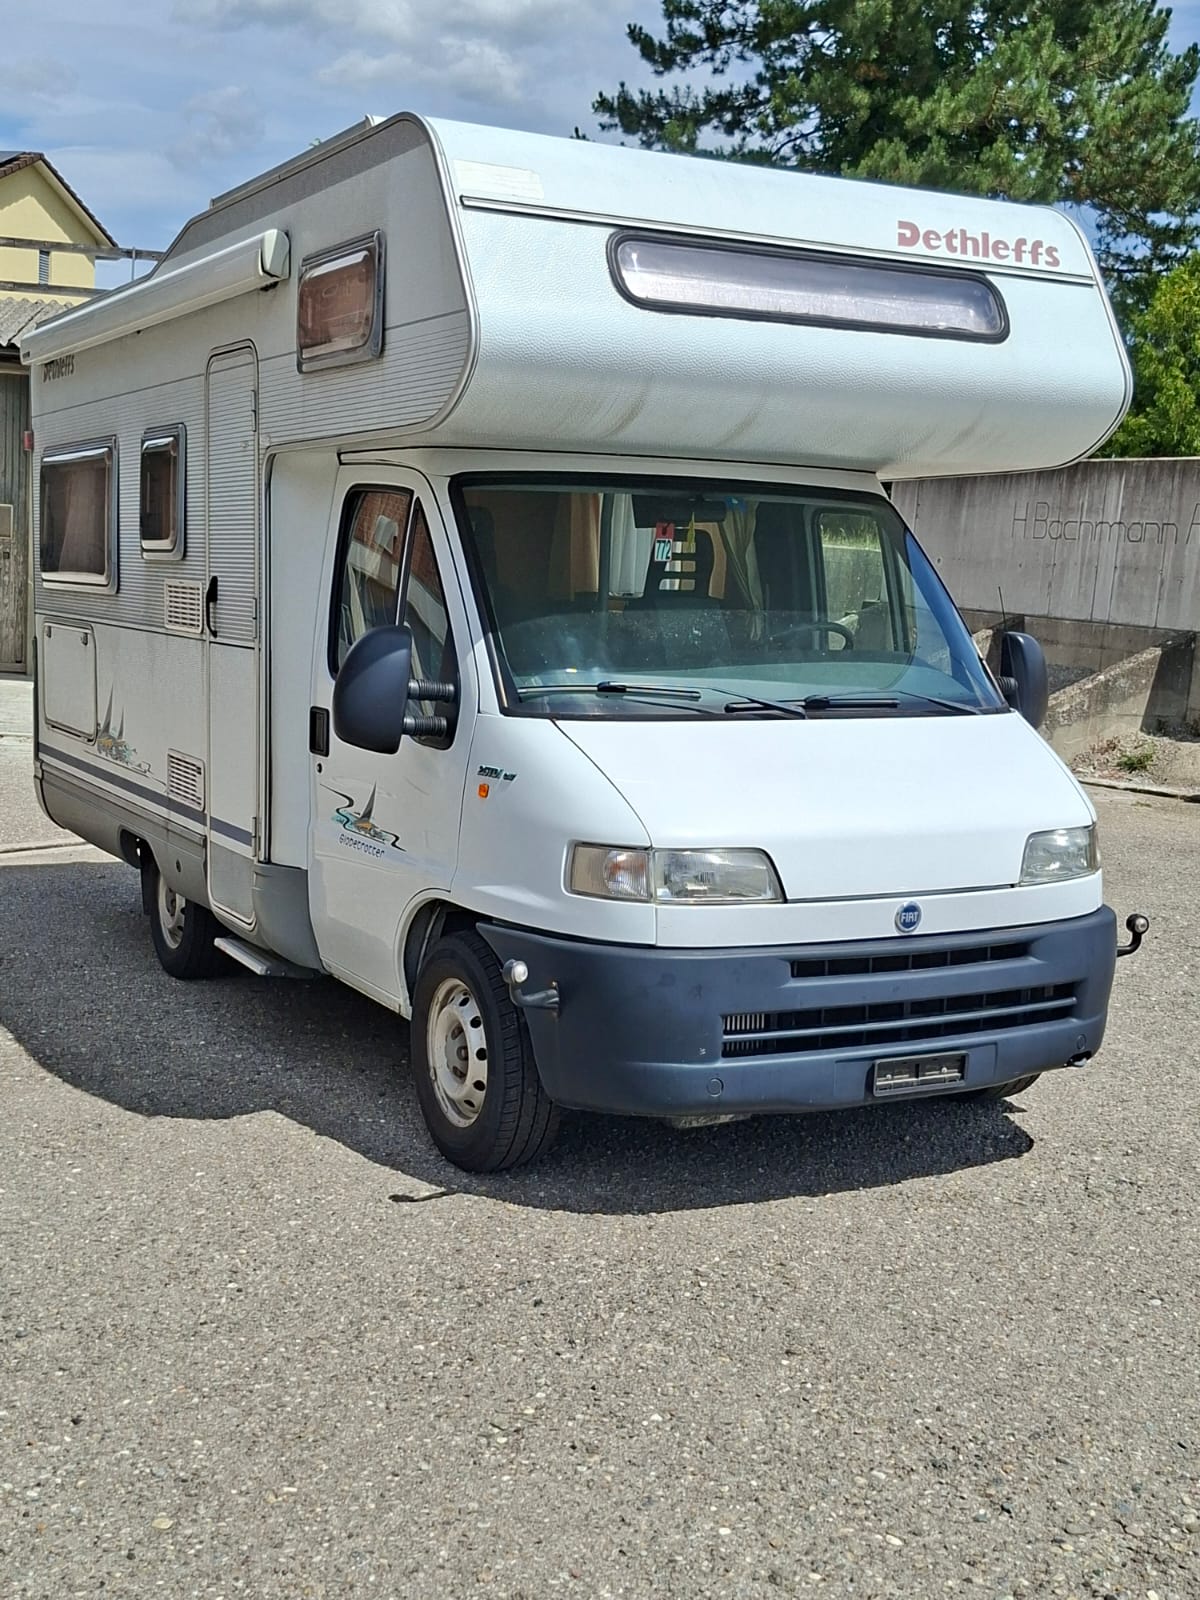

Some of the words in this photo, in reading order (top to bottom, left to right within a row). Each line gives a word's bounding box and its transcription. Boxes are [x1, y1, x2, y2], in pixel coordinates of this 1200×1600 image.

[897, 220, 1061, 268] Dethleffs
[1011, 501, 1029, 540] H
[1032, 501, 1178, 545] Bachmann
[656, 540, 671, 560] 772
[900, 911, 919, 923] FIAT
